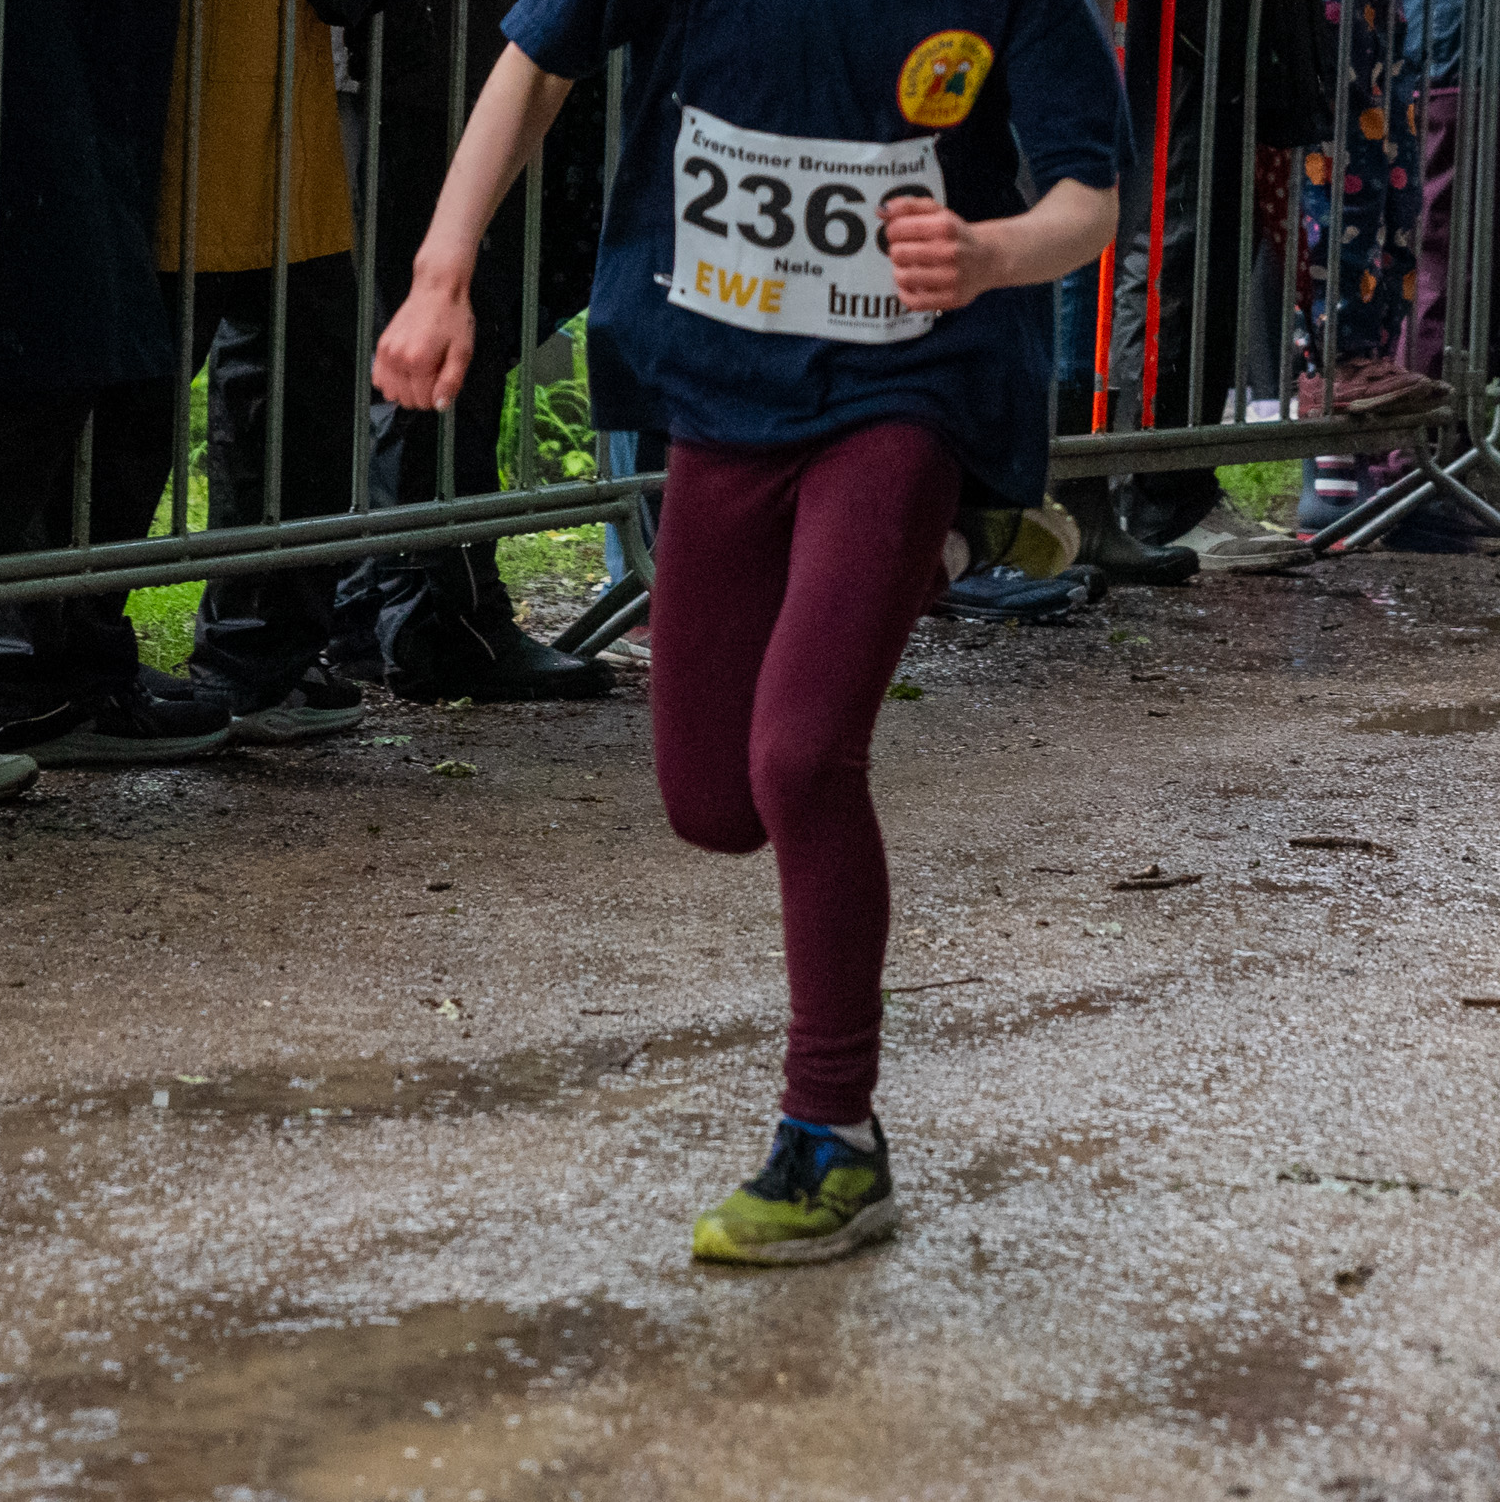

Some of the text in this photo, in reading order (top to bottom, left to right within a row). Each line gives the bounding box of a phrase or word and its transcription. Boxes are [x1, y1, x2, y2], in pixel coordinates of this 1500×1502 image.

[692, 129, 928, 177] Everstener Brunnenlauf
[695, 260, 785, 314] EWE
[828, 283, 908, 319] brun
